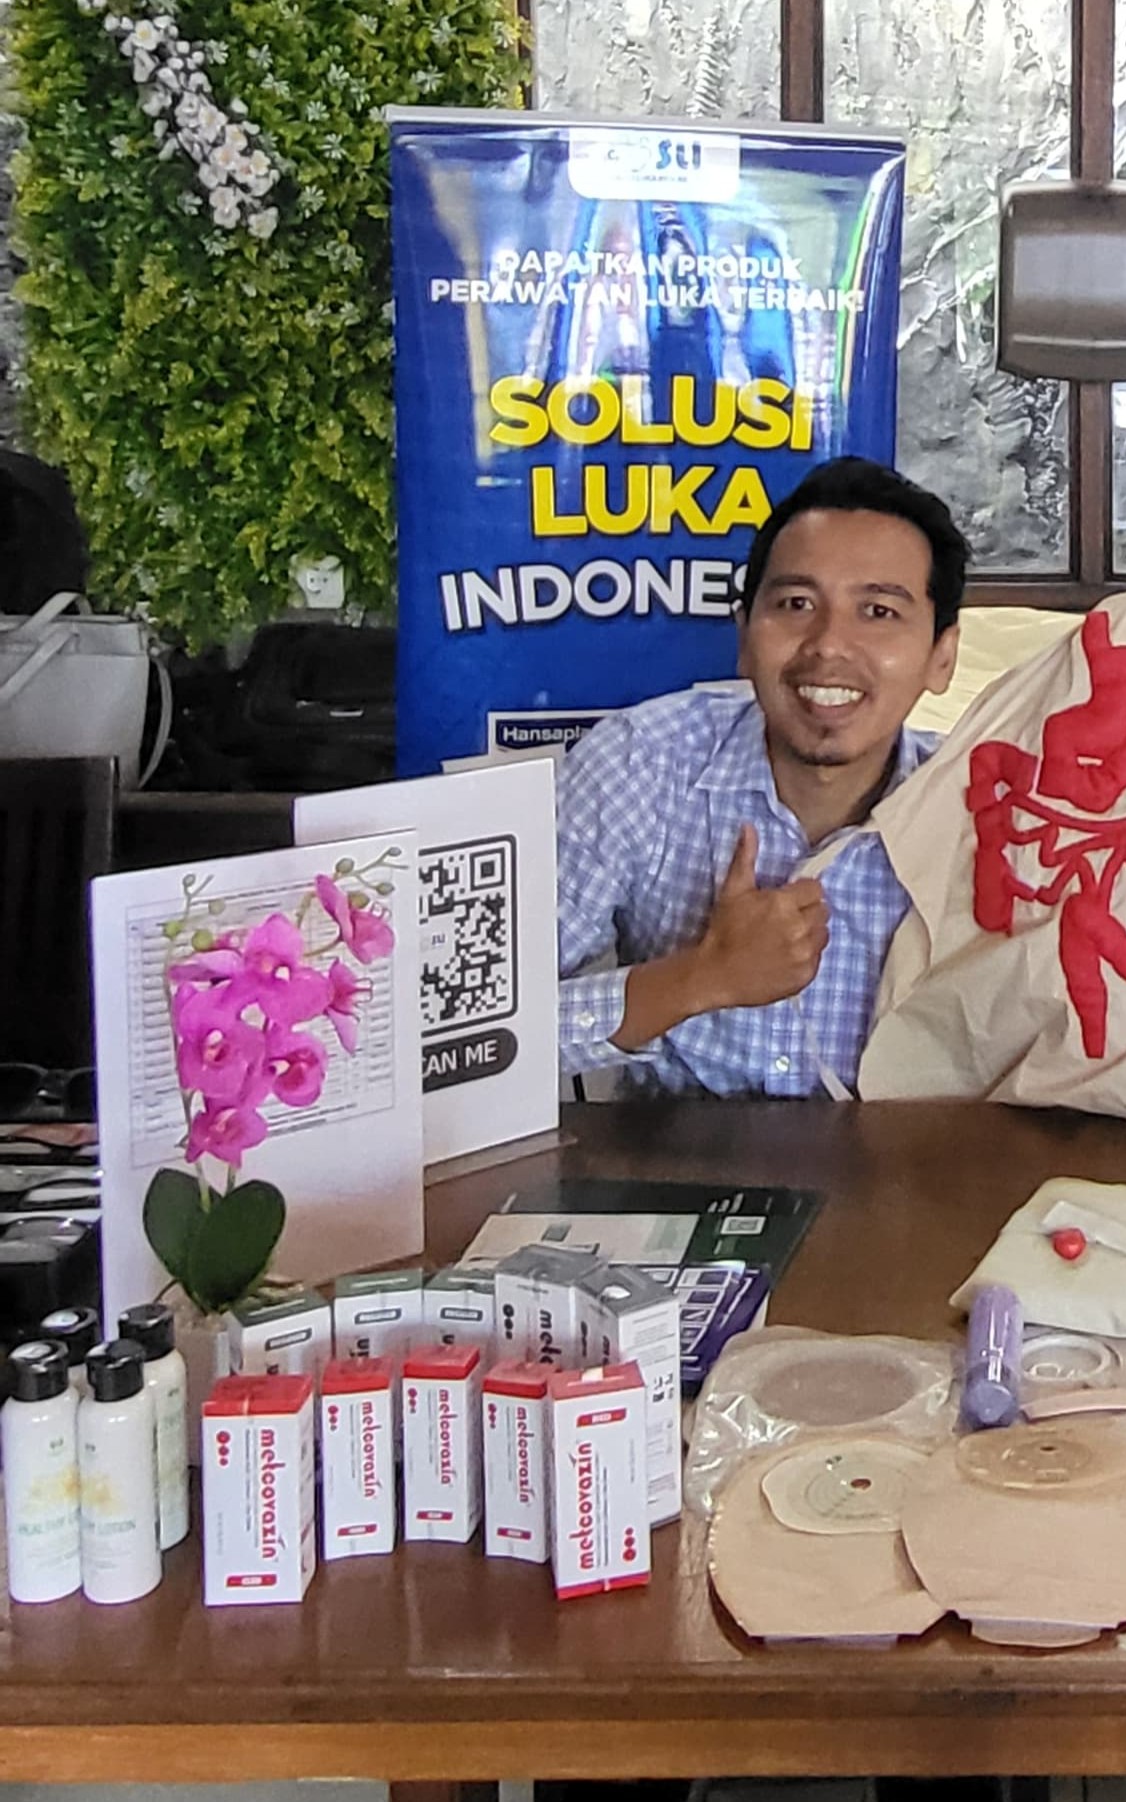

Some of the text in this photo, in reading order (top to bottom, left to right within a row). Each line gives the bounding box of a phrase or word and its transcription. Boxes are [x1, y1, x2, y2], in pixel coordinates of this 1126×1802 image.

[499, 250, 802, 281] DAPATKAN PRODUK
[431, 279, 866, 312] PERAWATAN LUKA TERBAIK!
[489, 374, 812, 451] SOLUSI
[529, 464, 772, 536] LUKA
[503, 725, 581, 742] Hansapl
[465, 1039, 498, 1068] ME
[260, 1429, 286, 1559] metcovazin
[569, 1441, 594, 1569] metcovazin
